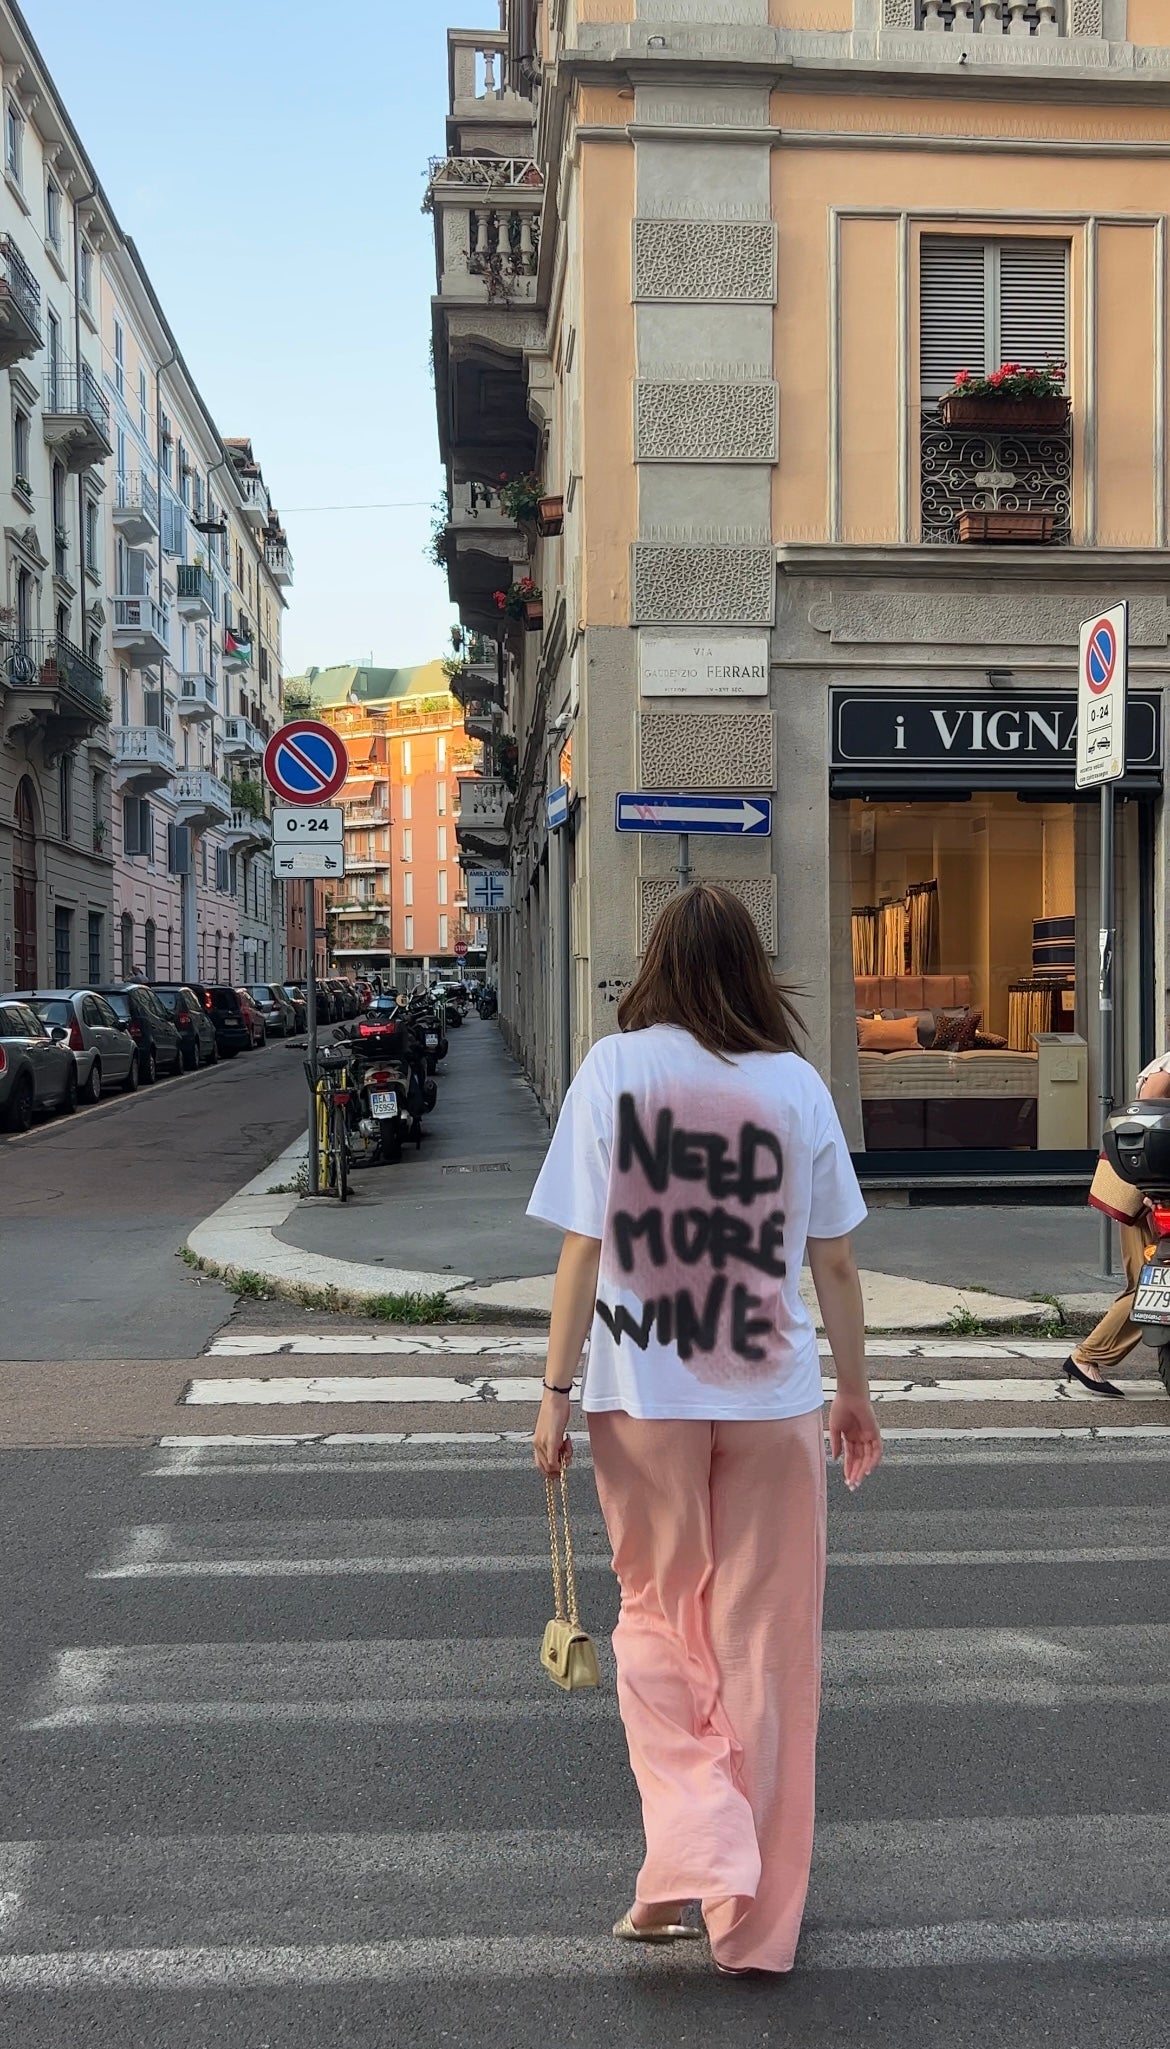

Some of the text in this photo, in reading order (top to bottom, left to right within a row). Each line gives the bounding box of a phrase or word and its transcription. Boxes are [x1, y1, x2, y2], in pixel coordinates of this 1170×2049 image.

[693, 648, 713, 656] VIA
[707, 665, 765, 678] FERRARI
[1090, 704, 1109, 721] 0-24
[894, 715, 908, 749] i
[287, 819, 329, 831] 0-24
[469, 869, 510, 877] AMBULATORIO
[469, 905, 511, 913] VETERINARIO
[617, 1091, 785, 1206] NEED
[612, 1205, 787, 1279] MORE
[1150, 1268, 1169, 1285] EK
[595, 1271, 775, 1362] WINE
